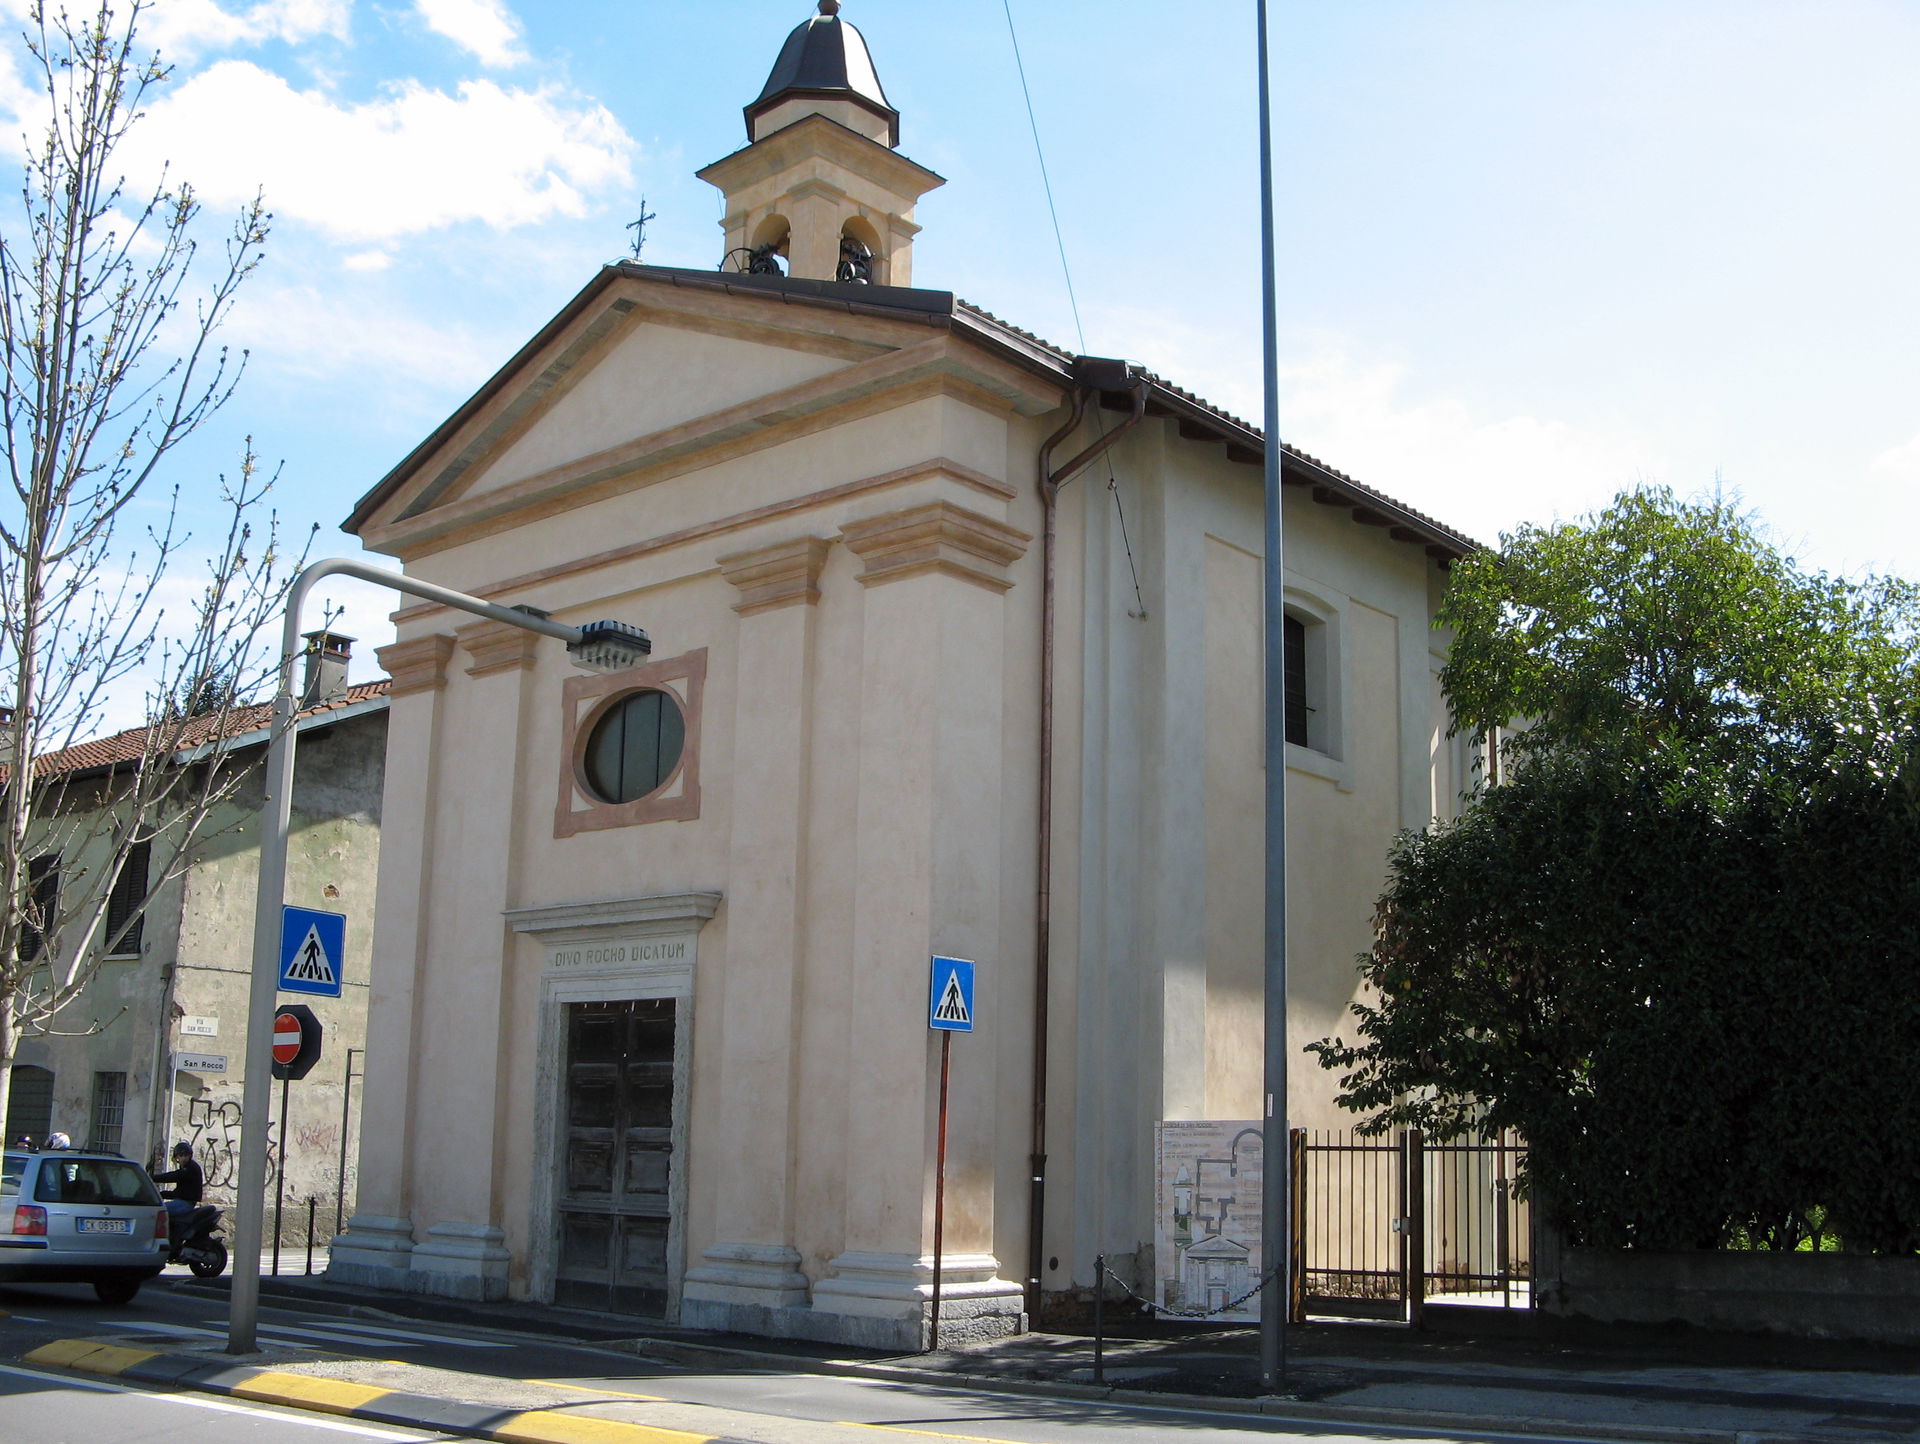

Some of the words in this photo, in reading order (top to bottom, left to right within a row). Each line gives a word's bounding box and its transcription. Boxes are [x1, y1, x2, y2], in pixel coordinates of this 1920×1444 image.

[555, 951, 581, 967] DIVO
[586, 947, 626, 963] ROCHO
[631, 942, 685, 961] DICATUM
[184, 1059, 198, 1067] San
[201, 1061, 224, 1070] Rocco
